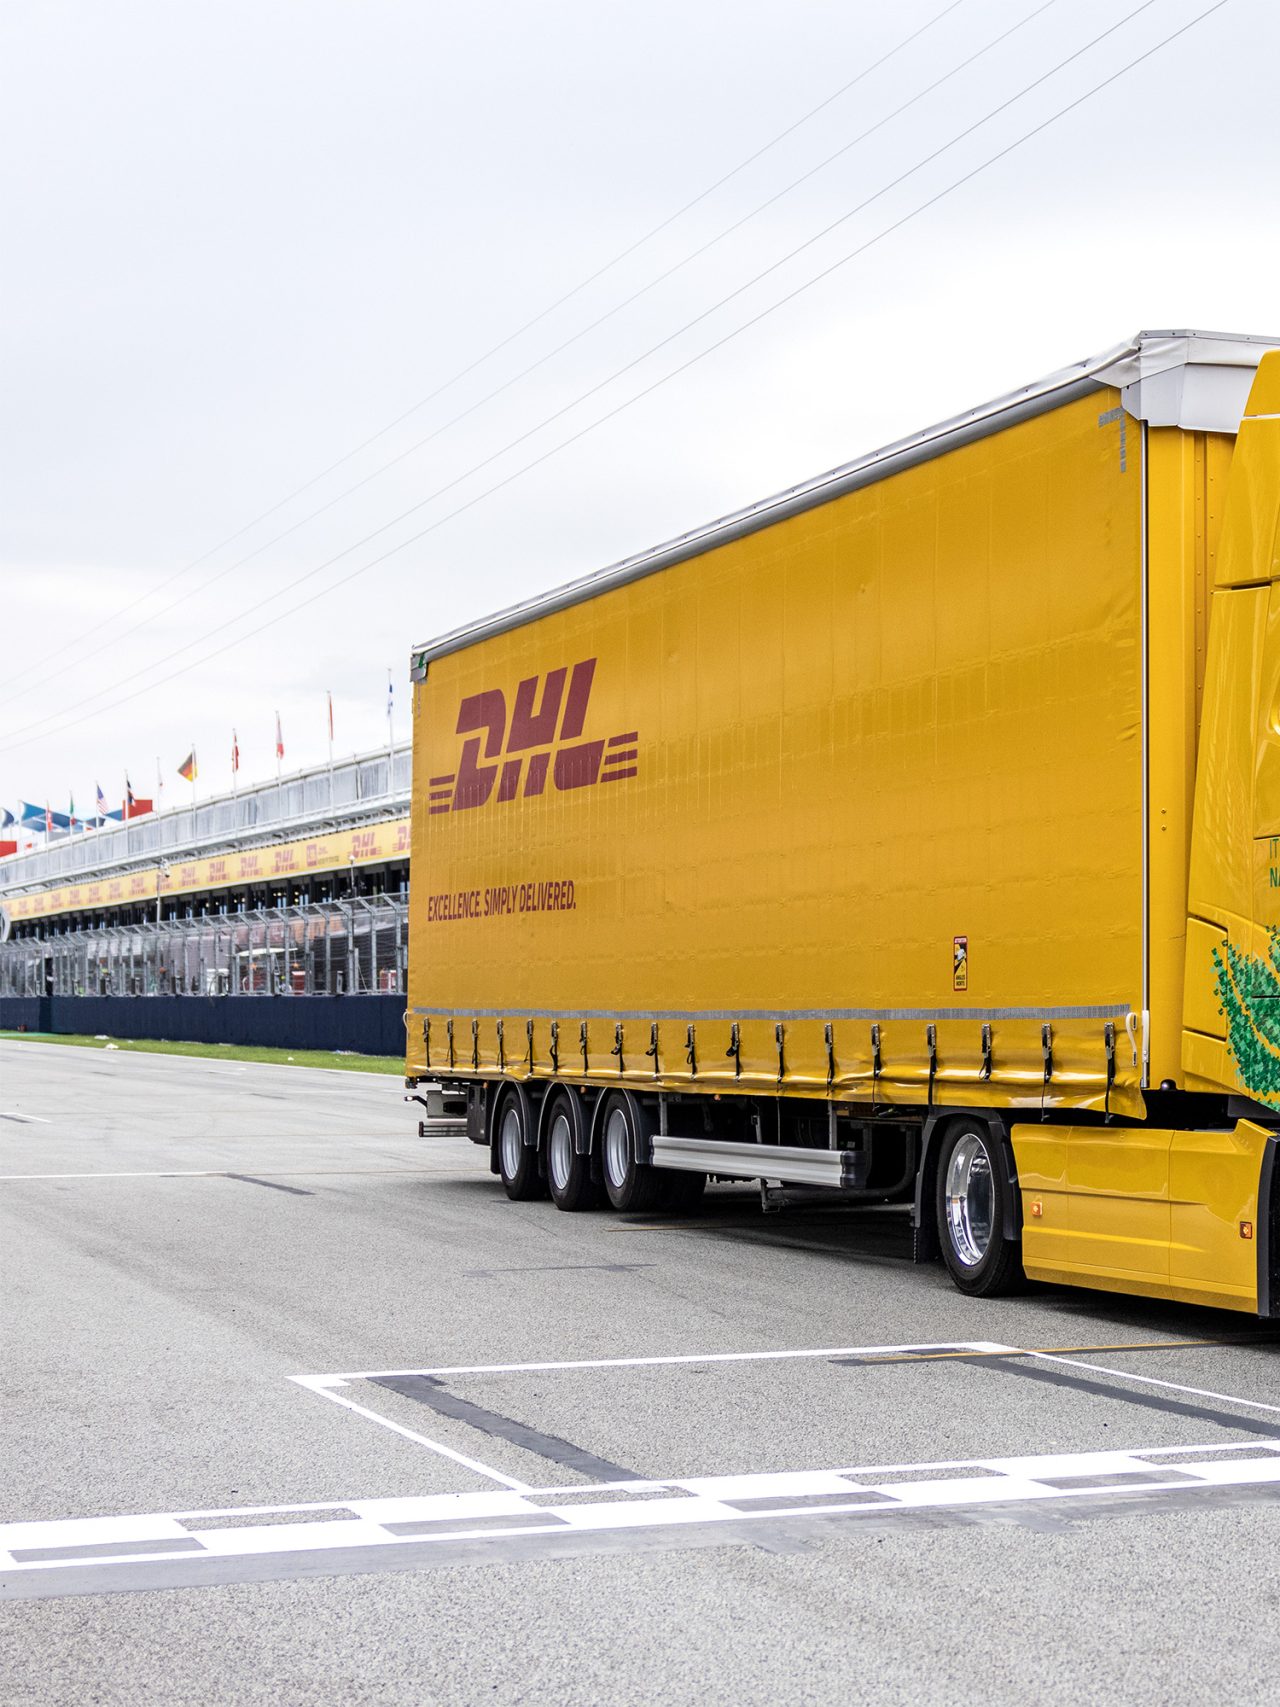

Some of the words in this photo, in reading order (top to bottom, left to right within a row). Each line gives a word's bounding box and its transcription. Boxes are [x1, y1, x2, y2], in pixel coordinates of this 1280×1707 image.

[450, 657, 608, 811] DHL
[427, 890, 482, 921] EXCELLENCE.
[484, 885, 518, 916] SIMPLY
[518, 880, 576, 912] DELIVERED.
